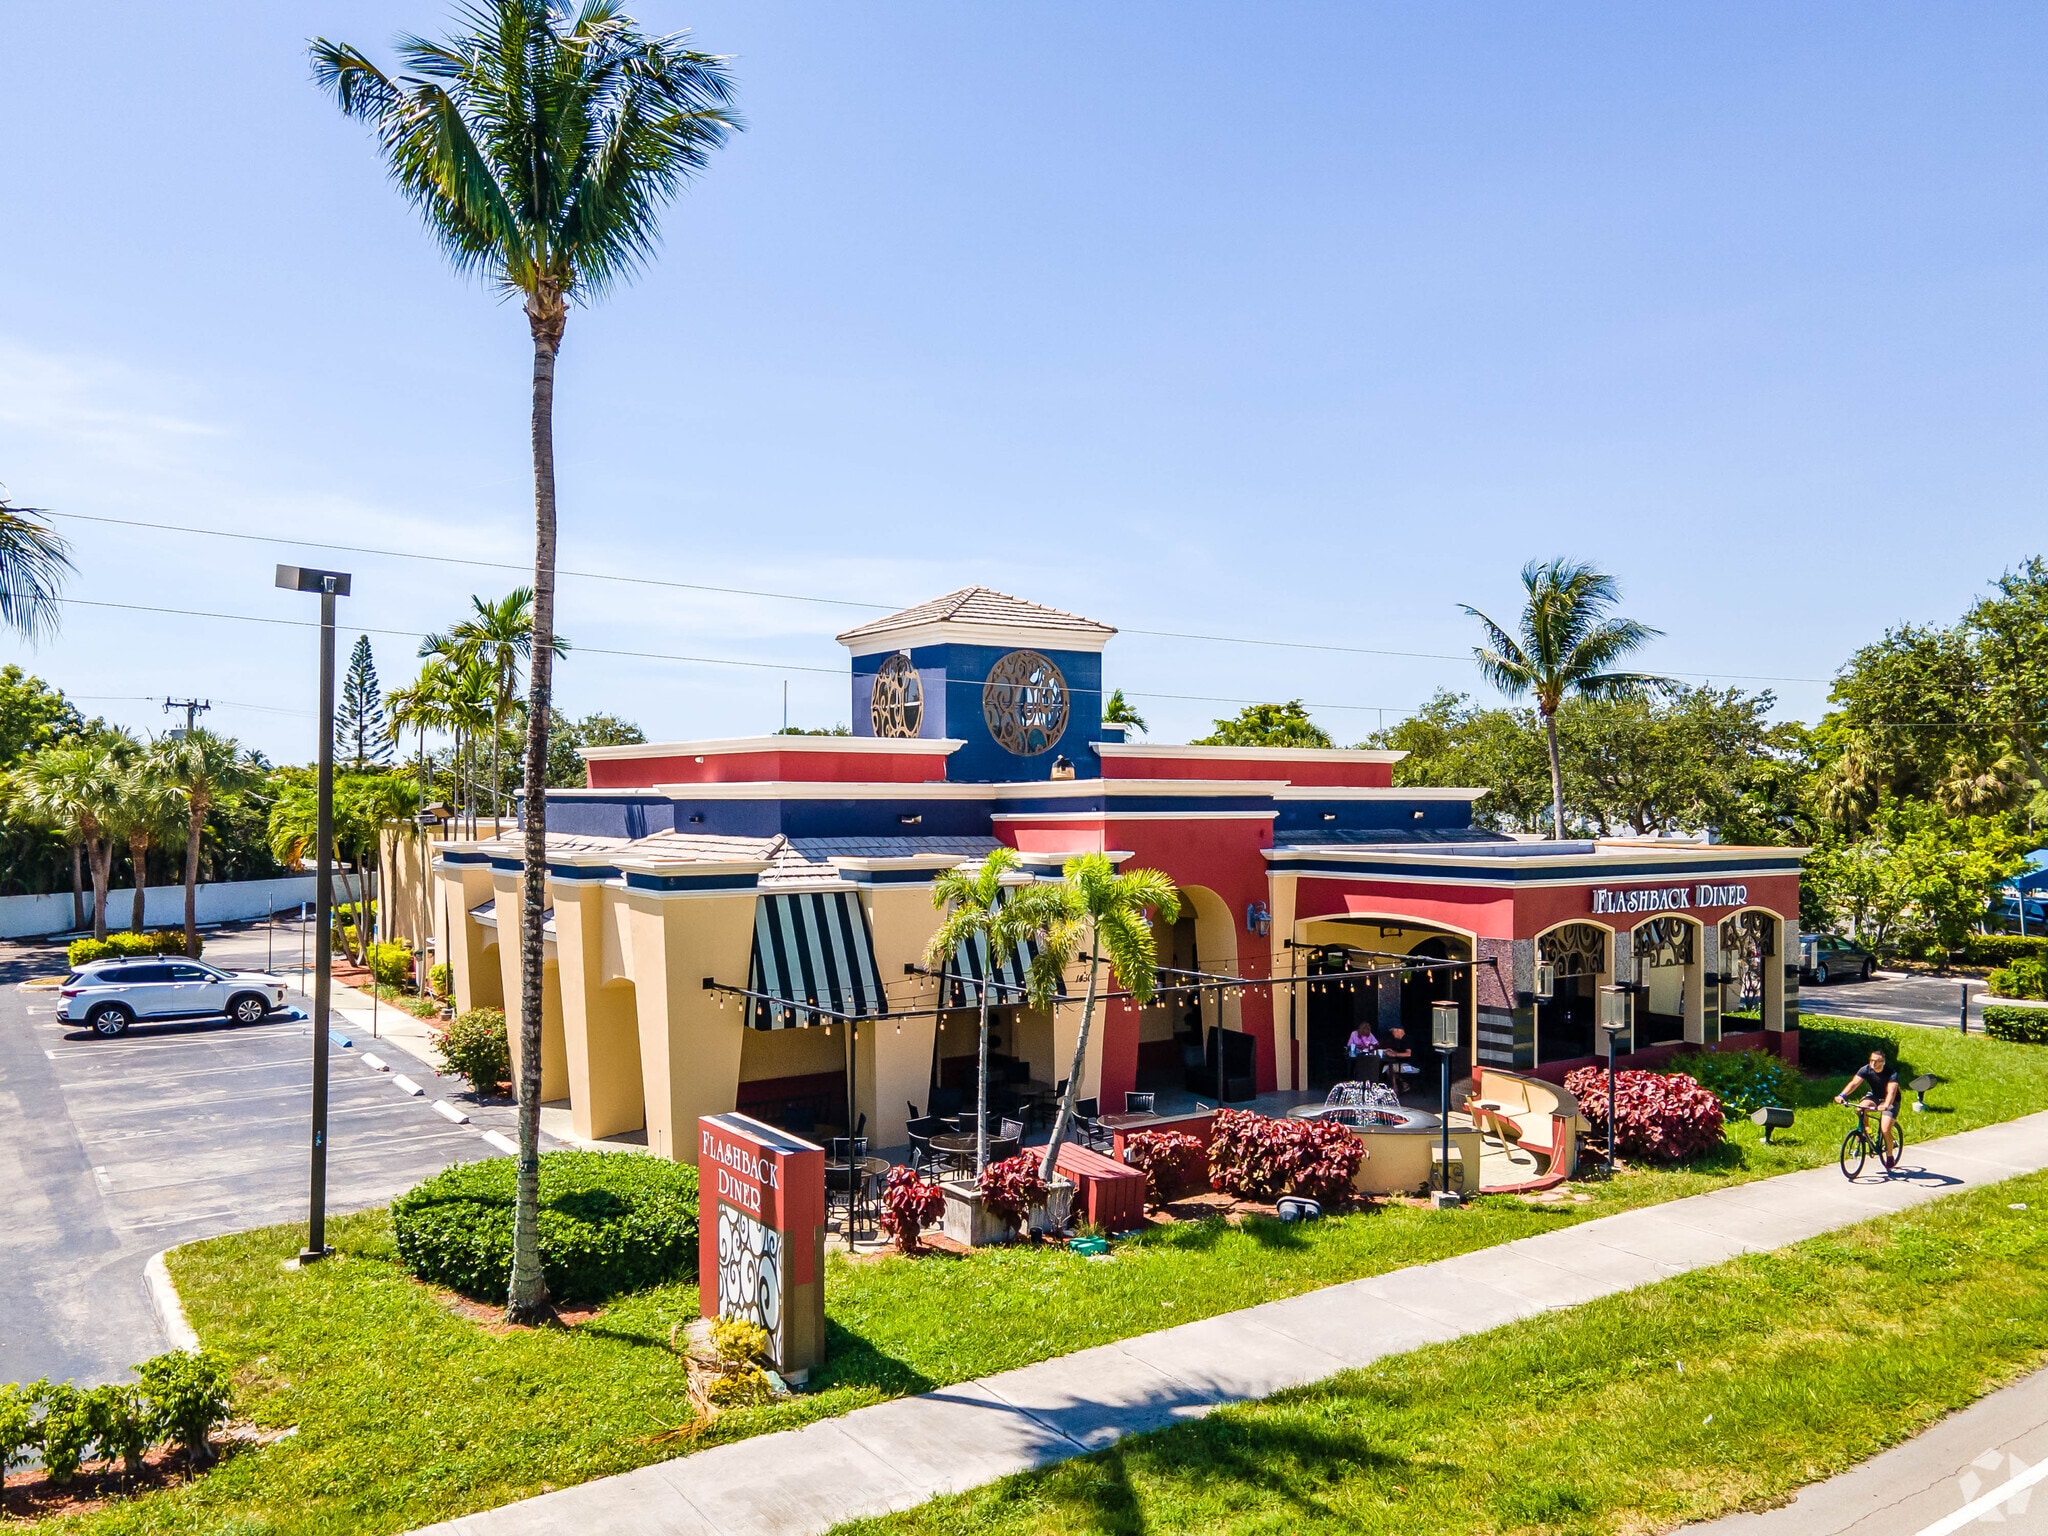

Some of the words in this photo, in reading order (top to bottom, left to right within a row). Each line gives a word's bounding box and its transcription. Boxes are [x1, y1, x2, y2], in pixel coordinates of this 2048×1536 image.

[1593, 887, 1690, 914] FLASHBACK
[1696, 884, 1748, 907] DINER
[702, 1130, 779, 1190] FLASHBACK
[718, 1168, 761, 1213] DINER
